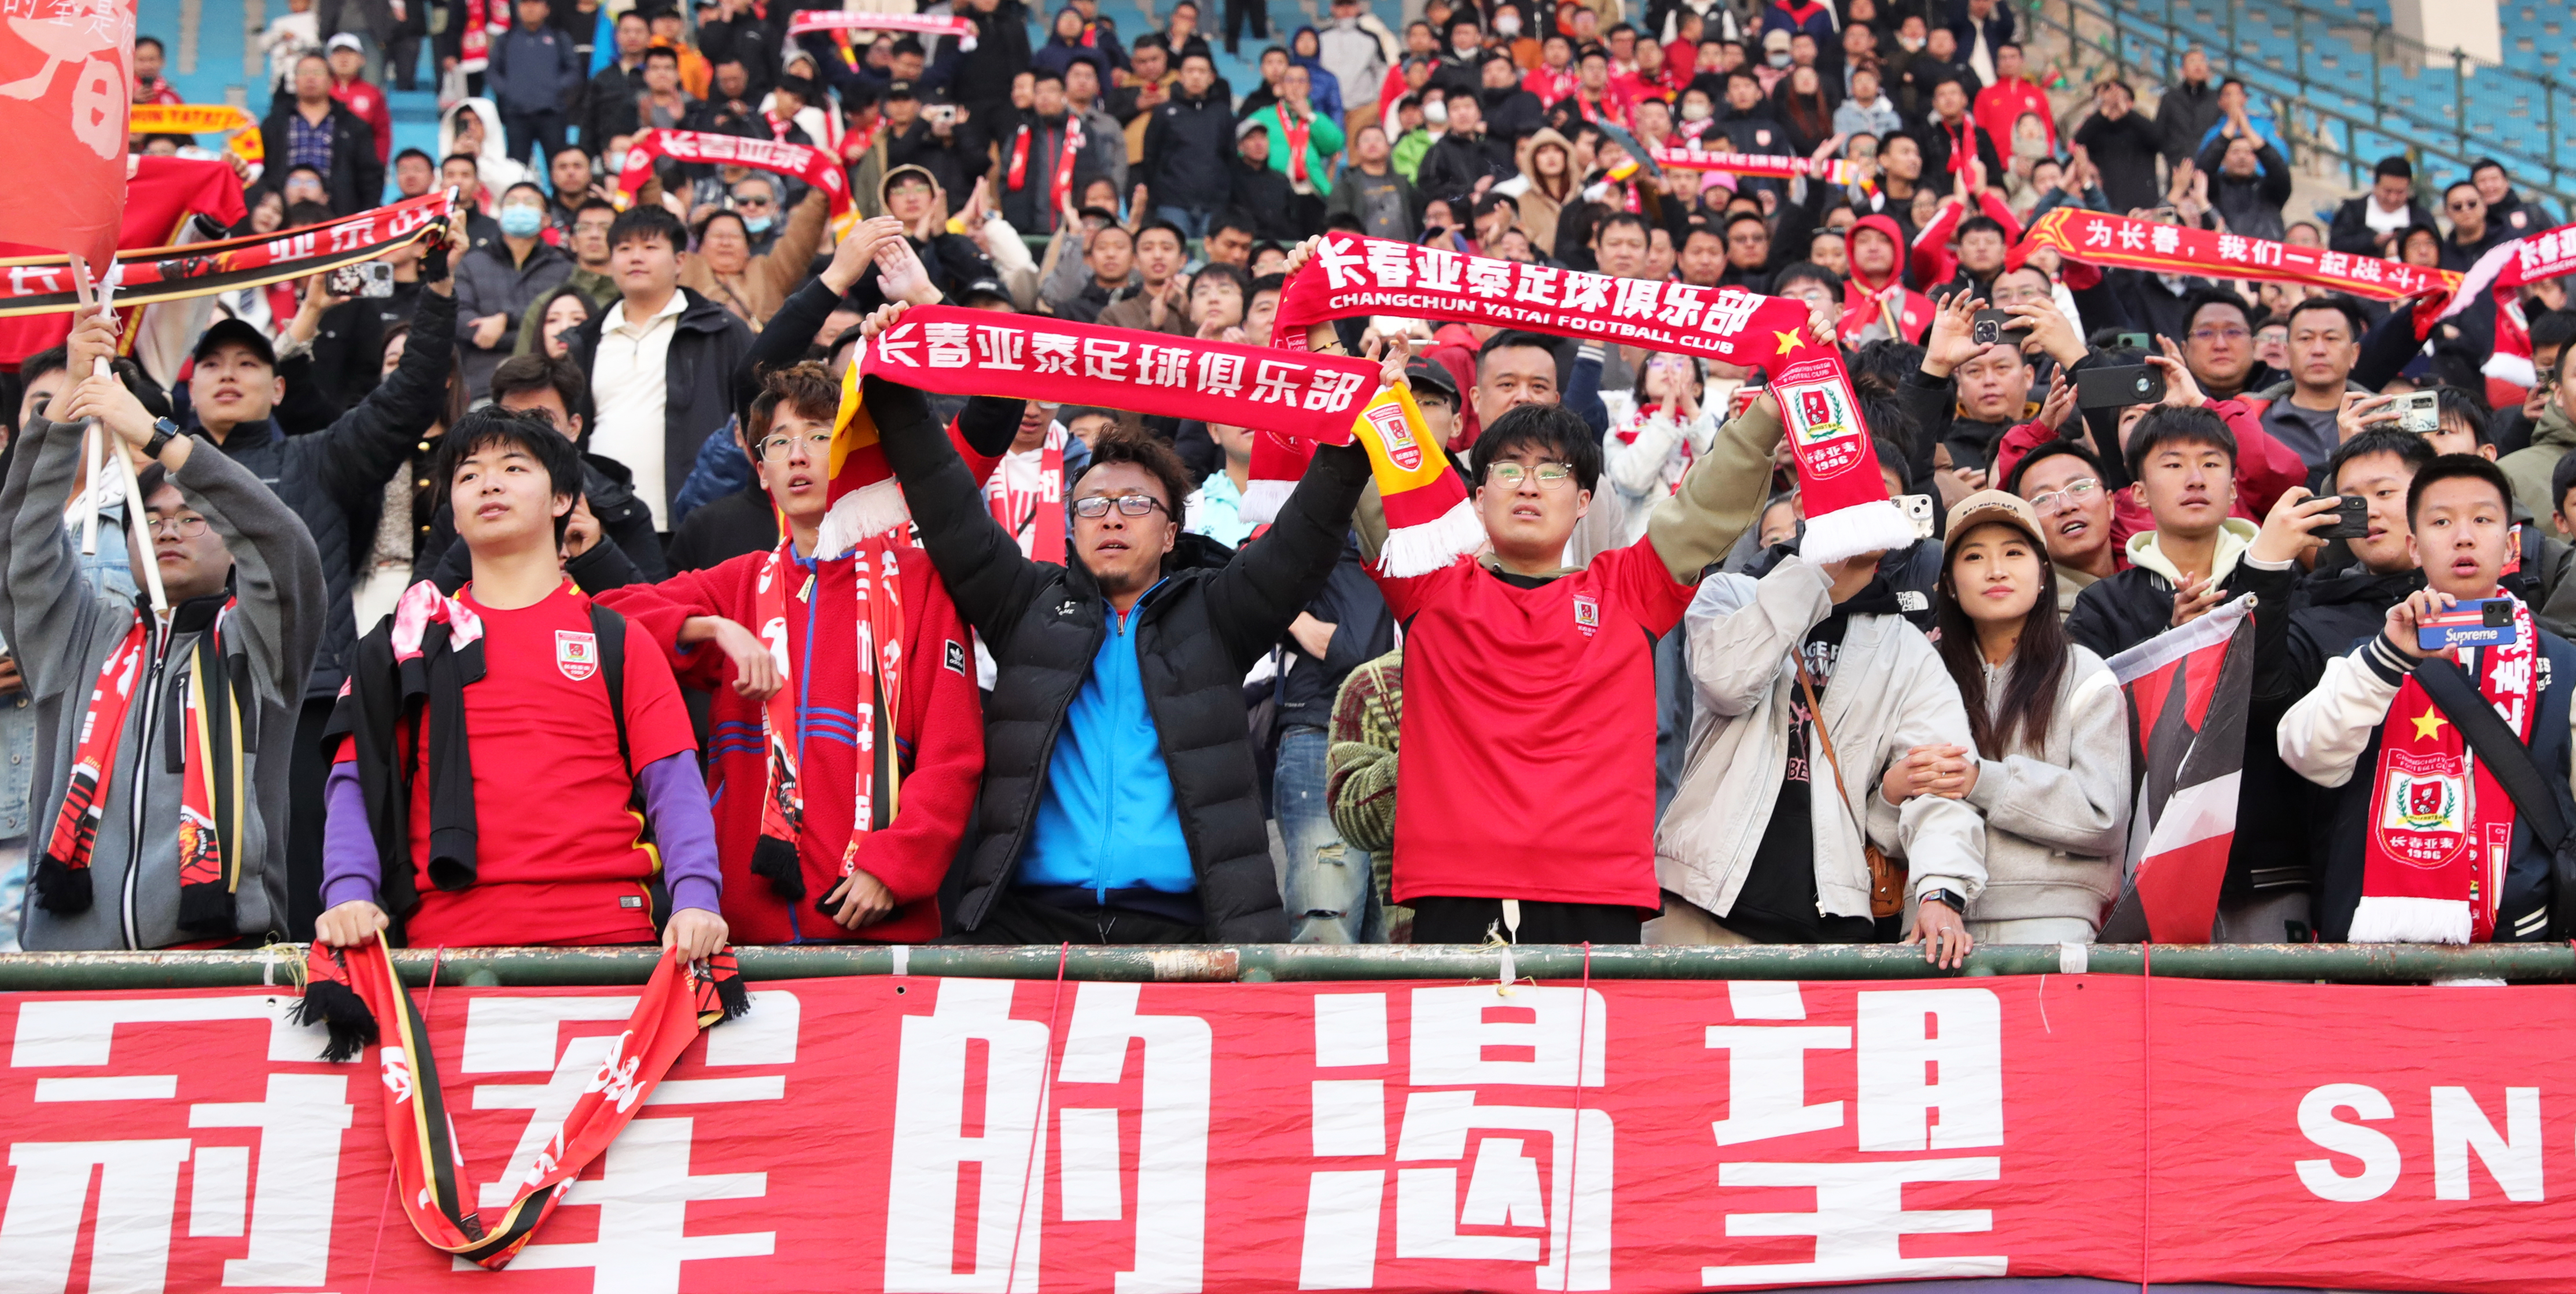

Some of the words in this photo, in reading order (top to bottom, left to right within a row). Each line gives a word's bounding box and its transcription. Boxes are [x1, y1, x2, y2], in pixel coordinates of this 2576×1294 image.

[658, 130, 814, 173] 长春亚泰
[1316, 236, 1767, 337] 长春亚泰足球俱乐部
[1329, 292, 1477, 313] CHANGCHUN
[1483, 302, 1550, 324] YATAI
[1557, 316, 1675, 344] FOOTBALL
[1679, 335, 1735, 355] CLUB
[877, 322, 1366, 413] 长春亚泰足球俱乐部
[1815, 455, 1849, 472] 1996
[2445, 628, 2498, 645] Supreme
[2389, 835, 2454, 850] 长春亚泰
[2406, 848, 2442, 860] 1996
[0, 978, 2010, 1294] 冠军的渴望
[2294, 1082, 2545, 1203] SN
